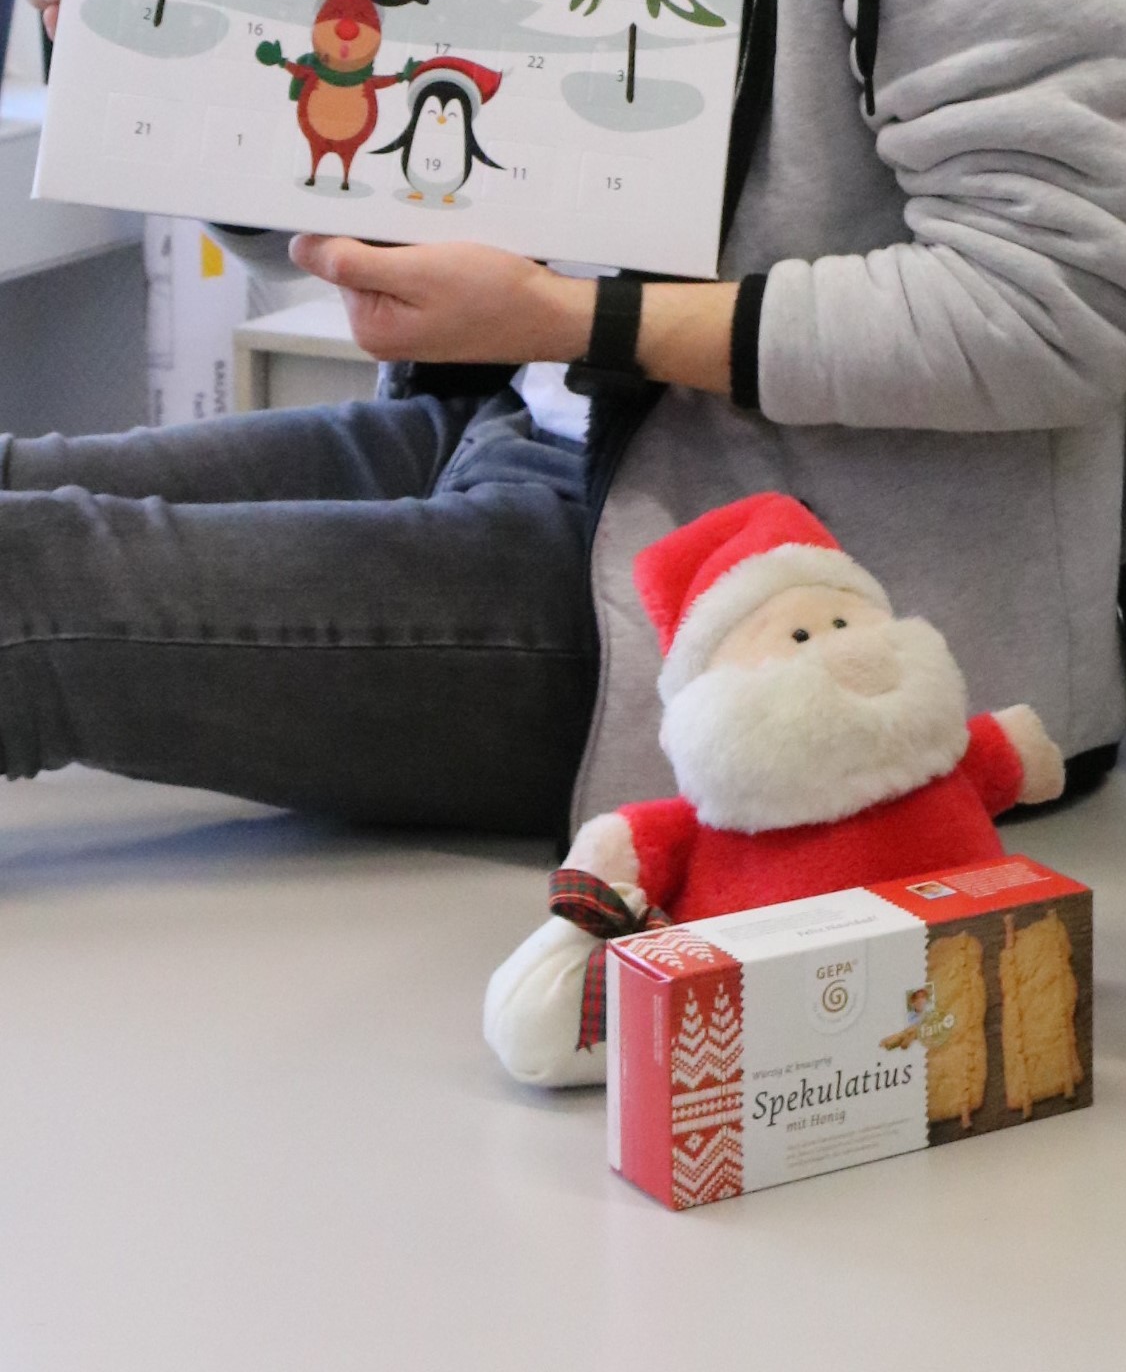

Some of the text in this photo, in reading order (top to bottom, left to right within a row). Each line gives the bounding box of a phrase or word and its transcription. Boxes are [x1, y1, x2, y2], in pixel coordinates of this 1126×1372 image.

[143, 7, 151, 20] 2
[248, 22, 263, 36] 16
[434, 42, 450, 54] 17
[527, 55, 545, 69] 22
[616, 70, 625, 83] 3
[134, 121, 151, 135] 21
[236, 134, 243, 146] 1
[425, 158, 441, 171] 19
[512, 166, 527, 180] 11
[606, 177, 622, 191] 15
[752, 1062, 912, 1127] Spekulatius
[787, 1109, 846, 1132] mit Honig
